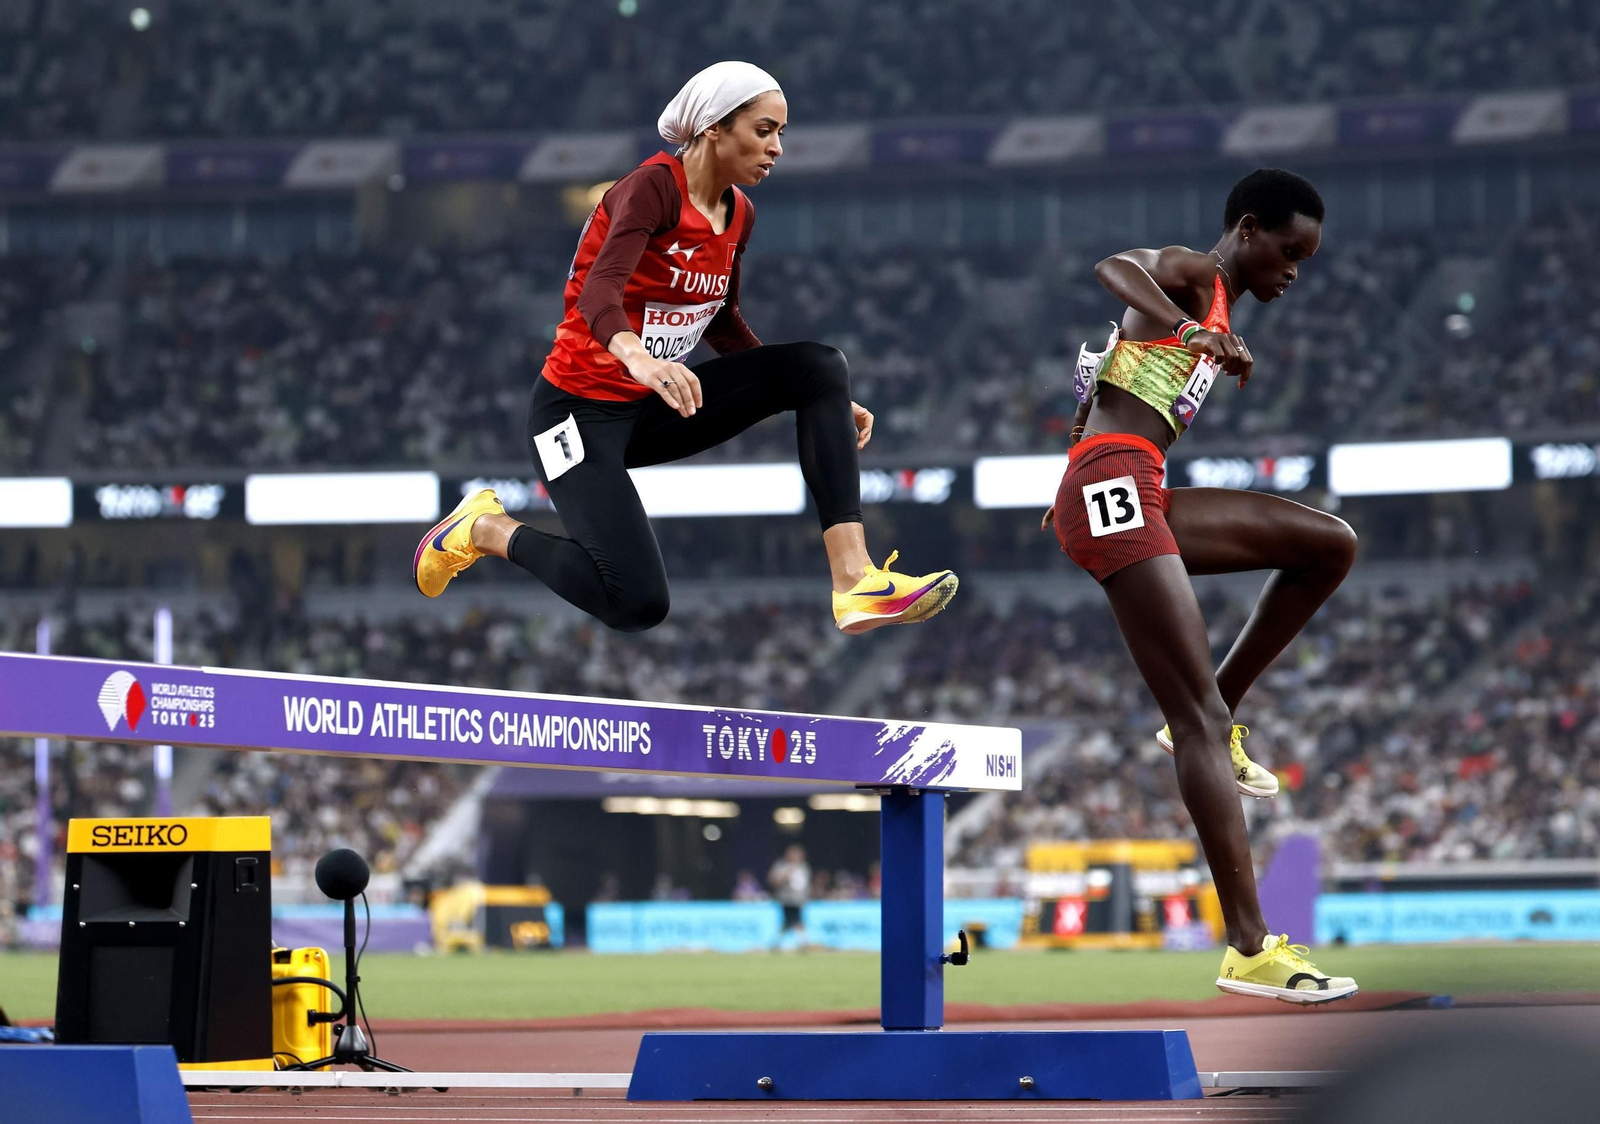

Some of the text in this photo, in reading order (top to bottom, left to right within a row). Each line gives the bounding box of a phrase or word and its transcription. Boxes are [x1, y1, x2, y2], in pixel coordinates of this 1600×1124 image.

[553, 430, 573, 462] 1
[1091, 486, 1135, 528] 13
[151, 683, 215, 699] WORLD ATHLETICS
[151, 696, 215, 713] CHAMPIONSHIPS
[283, 696, 652, 755] WORLD ATHLETICS CHAMPIONSHIPS
[985, 753, 1017, 779] NISHI
[91, 824, 188, 847] SEIKO
